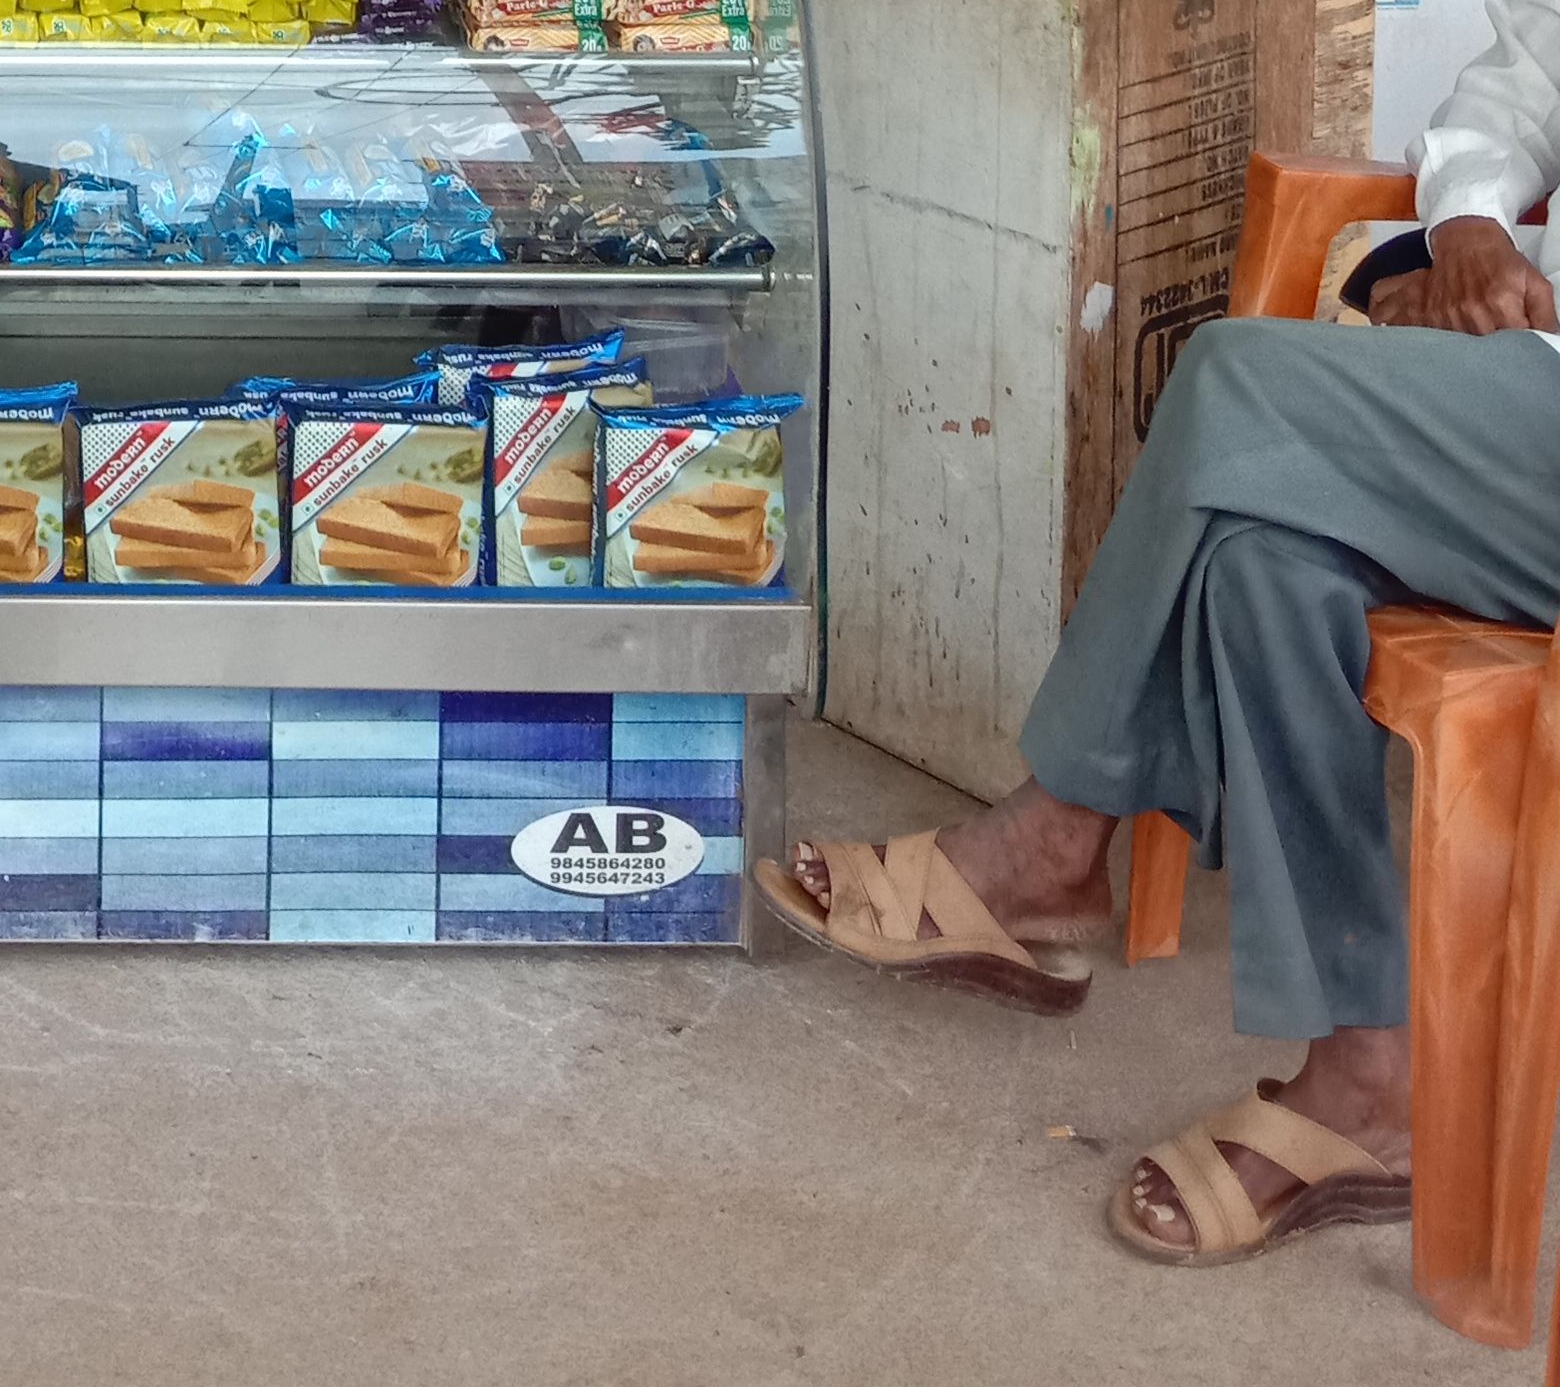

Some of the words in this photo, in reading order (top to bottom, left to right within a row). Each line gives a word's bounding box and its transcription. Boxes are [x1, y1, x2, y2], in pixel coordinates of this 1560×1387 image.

[574, 4, 598, 17] Extra
[721, 4, 745, 17] Extra
[504, 404, 553, 466] modern
[512, 432, 552, 485] sunbake
[552, 404, 577, 434] rusk
[94, 435, 147, 492] modern
[104, 461, 150, 509] sunbake
[149, 436, 175, 465] rusk
[302, 436, 360, 489] modern
[313, 463, 359, 508] sunbake
[360, 437, 388, 466] rusk
[616, 441, 670, 495] modern
[625, 469, 672, 512] sunbake
[671, 442, 699, 470] rusk
[550, 812, 668, 854] AB
[550, 857, 666, 870] 9845864280
[550, 872, 666, 885] 9945647243
